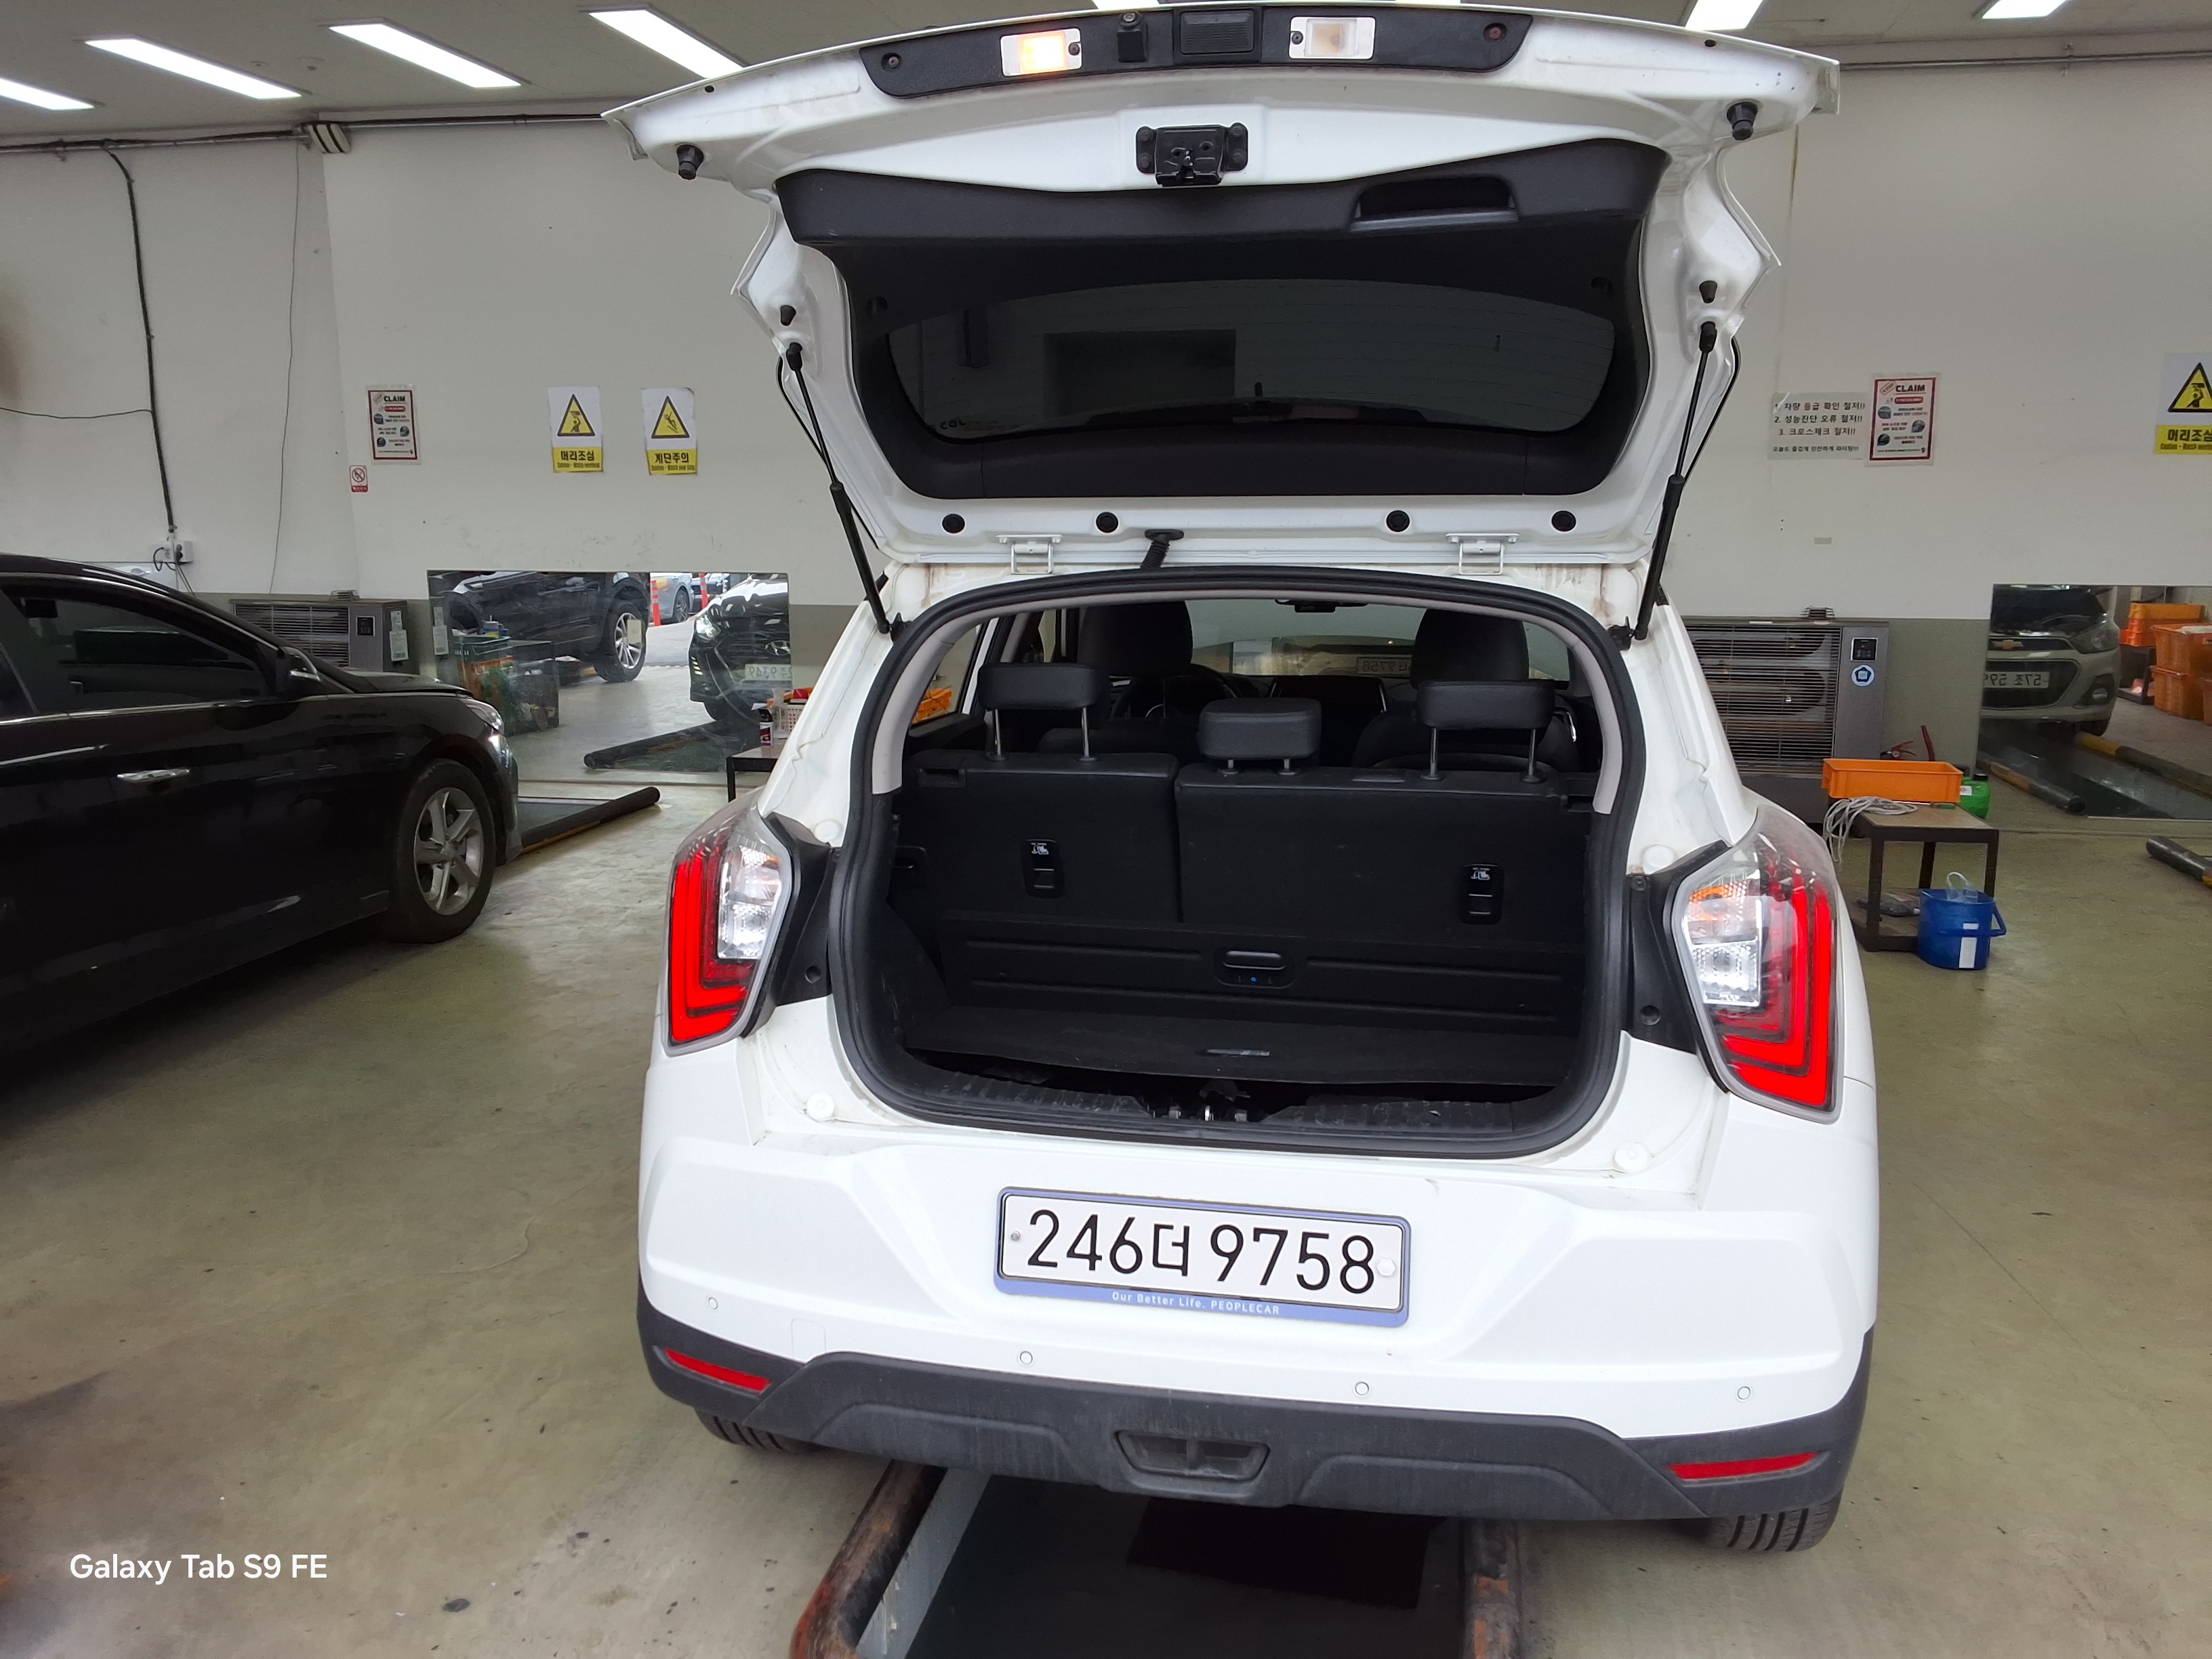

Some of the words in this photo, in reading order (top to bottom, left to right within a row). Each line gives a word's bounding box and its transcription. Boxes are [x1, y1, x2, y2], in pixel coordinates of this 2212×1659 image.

[1784, 403, 1800, 411] 차량
[1785, 415, 1818, 424] 성능진단
[1789, 428, 1830, 436] 크로스체크
[560, 450, 594, 461] 머리조심
[655, 452, 689, 464] 계단주의
[1027, 1209, 1190, 1277] 246더
[1210, 1224, 1374, 1294] 9758
[1112, 1291, 1132, 1301] Our
[1137, 1292, 1174, 1305] Better
[1179, 1297, 1206, 1309] Life.
[1211, 1300, 1279, 1315] PEOPLECAR
